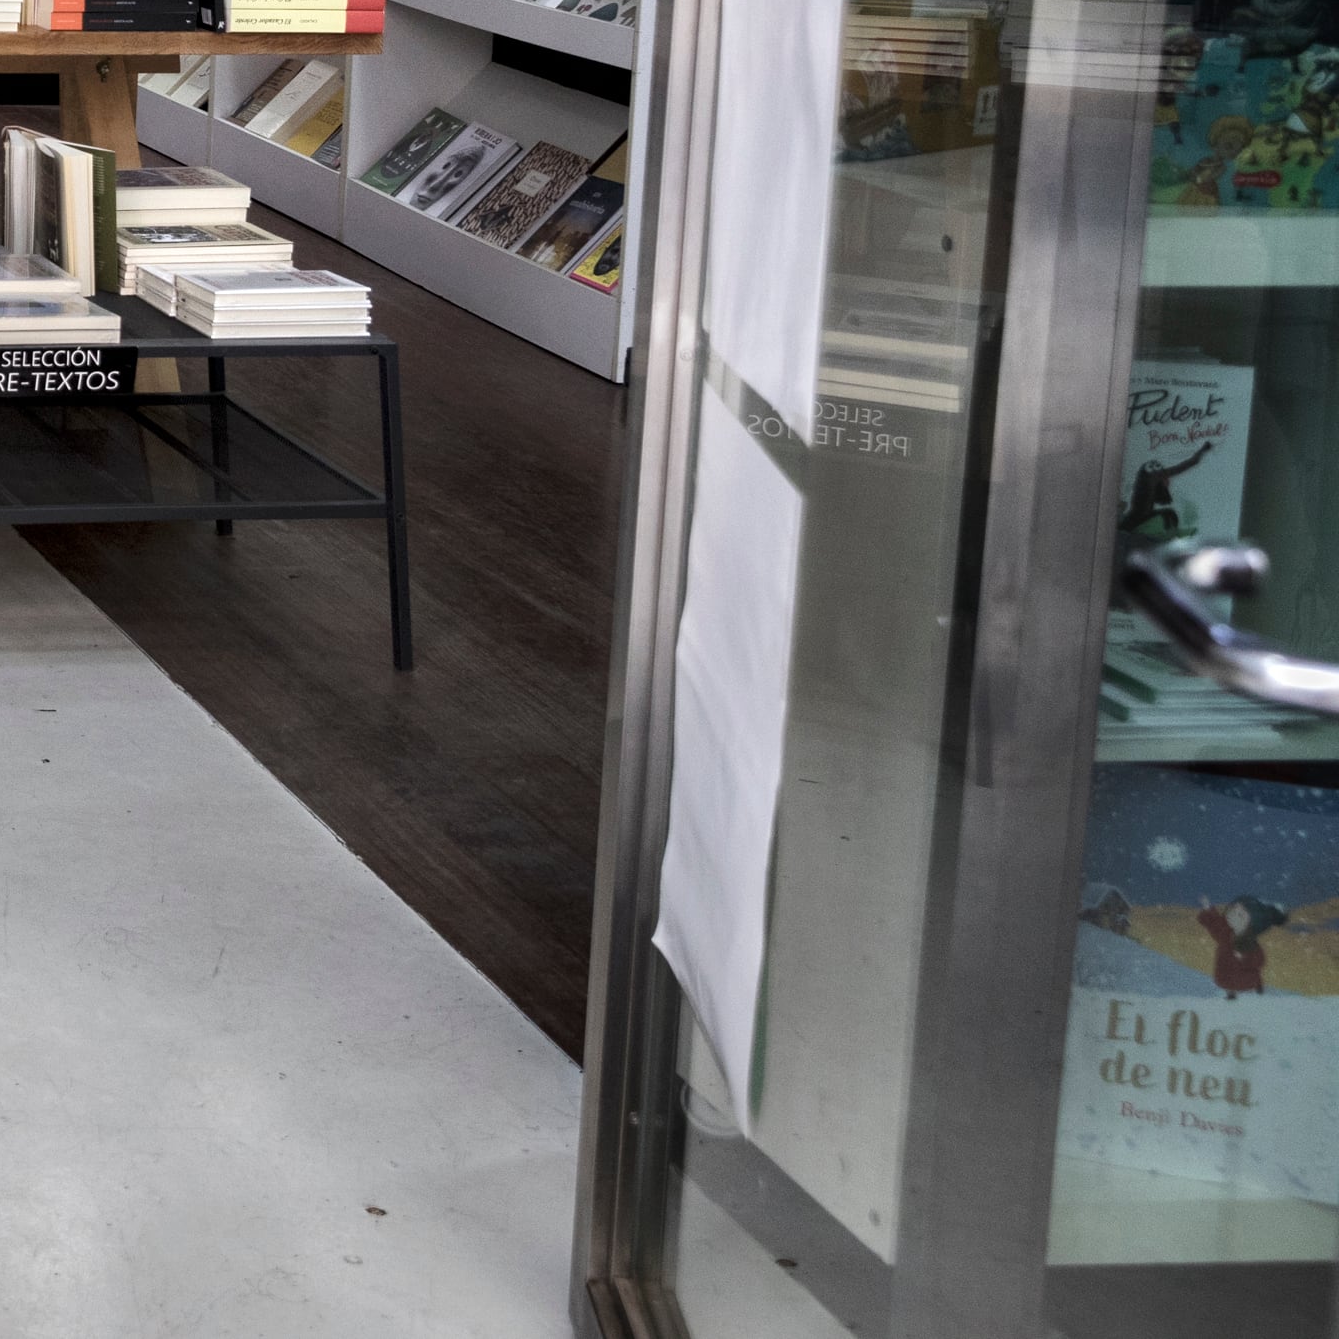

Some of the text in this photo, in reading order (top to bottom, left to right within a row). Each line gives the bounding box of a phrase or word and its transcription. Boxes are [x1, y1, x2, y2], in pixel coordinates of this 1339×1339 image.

[1, 346, 101, 368] SELECCIÓN
[1128, 389, 1224, 428] Pudent
[1167, 1009, 1258, 1062] floc
[1099, 1050, 1259, 1108] de neu
[1120, 1101, 1244, 1136] Benji Davies
